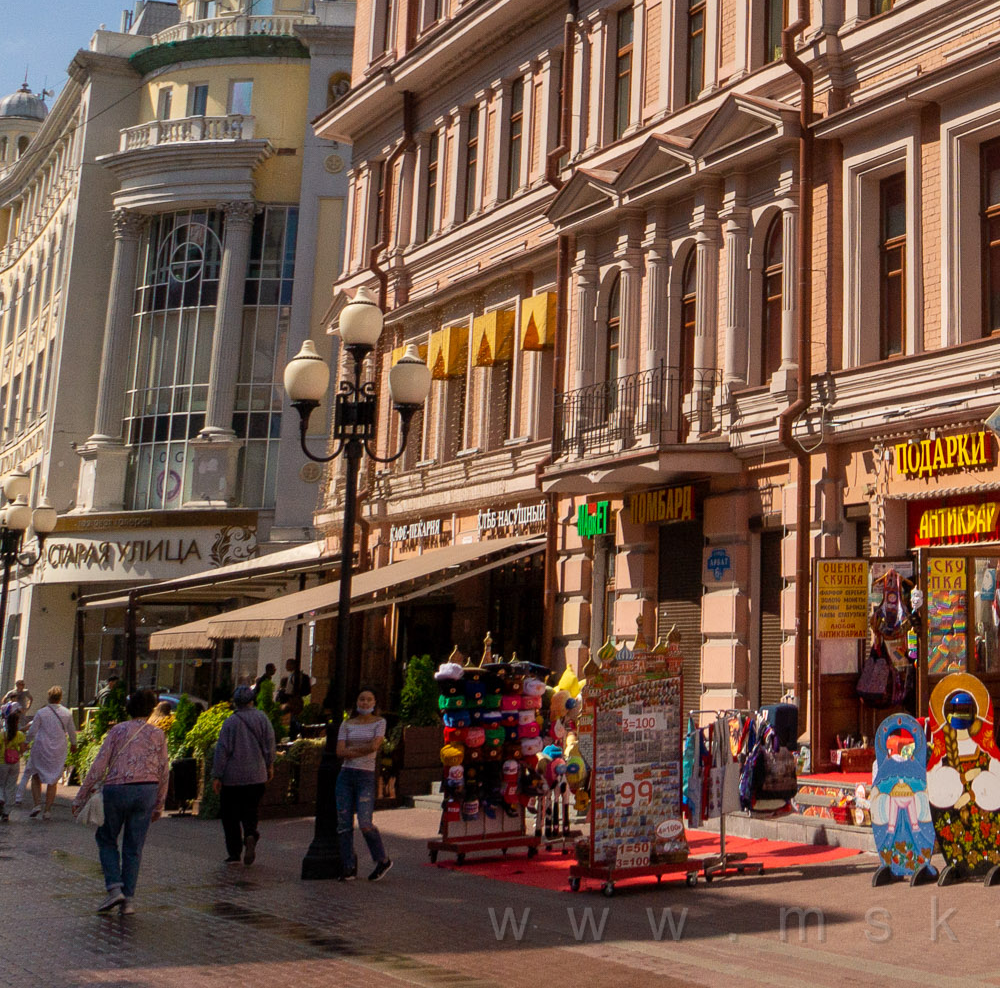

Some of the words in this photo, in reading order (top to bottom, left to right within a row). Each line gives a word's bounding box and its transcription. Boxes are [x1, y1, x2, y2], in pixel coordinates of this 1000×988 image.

[895, 431, 987, 478] ПОДАРКИ
[498, 500, 546, 527] НАСУЩНЫЙ
[630, 485, 693, 525] ЛОМБАРД
[390, 519, 440, 541] КАФЕ-ПЕКАРНЯ
[919, 502, 997, 539] АНТИКВАР
[48, 541, 110, 566] СТАРАЯ
[117, 539, 201, 564] УЛИЦА
[823, 563, 863, 574] ОЦЕНКА
[934, 560, 964, 573] СКУ
[823, 575, 863, 585] СКУПКА
[931, 575, 962, 589] ПКА
[620, 781, 653, 807] 99
[618, 843, 649, 855] 1=50
[616, 856, 650, 868] 3=100
